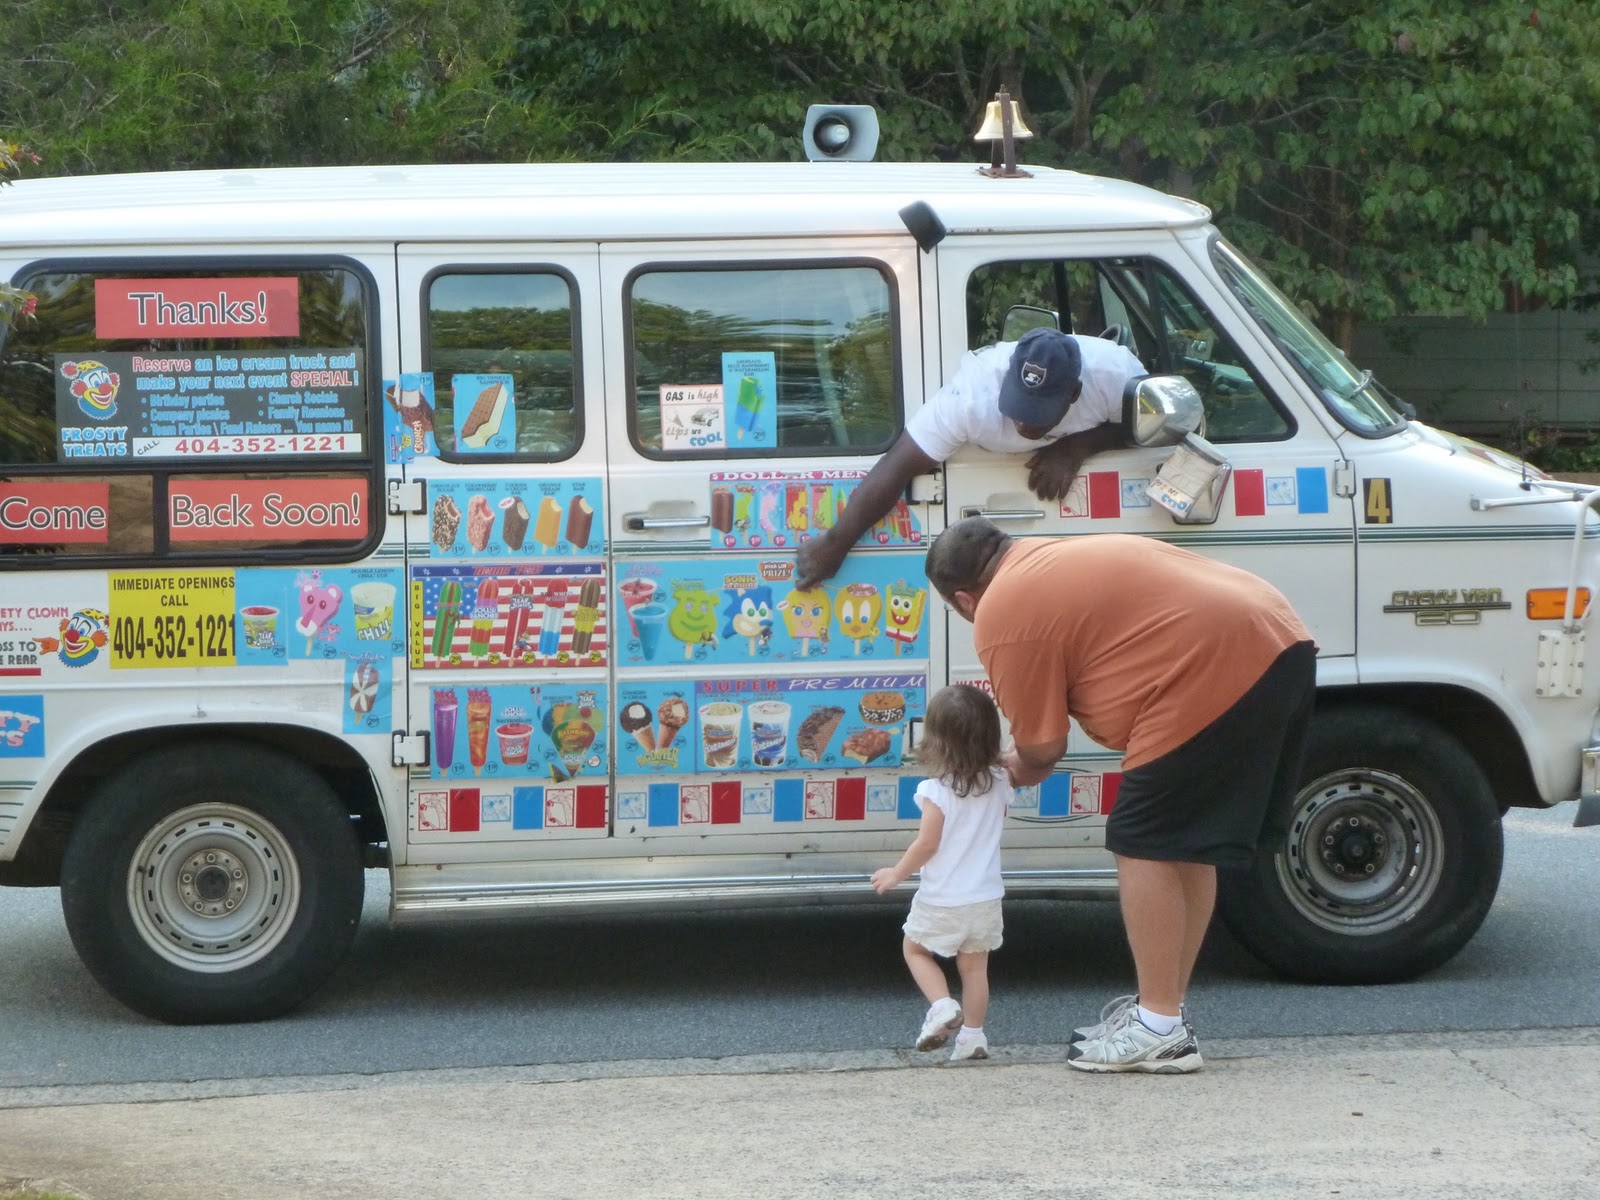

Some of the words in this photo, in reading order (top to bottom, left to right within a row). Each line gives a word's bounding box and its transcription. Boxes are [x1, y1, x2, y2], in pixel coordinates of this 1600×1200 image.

[129, 291, 267, 325] Thanks!
[133, 356, 191, 372] Reserve
[194, 359, 213, 372] an
[216, 355, 238, 371] ice
[241, 357, 287, 370] cream
[289, 354, 326, 369] truck
[329, 352, 356, 368] and
[136, 374, 176, 390] make
[178, 376, 211, 392] your
[214, 373, 245, 389] next
[248, 372, 288, 388] event
[150, 394, 189, 408] Birthday
[192, 394, 225, 407] parties
[268, 392, 302, 404] Church
[304, 391, 339, 404] Socials
[666, 392, 683, 401] GAS
[688, 392, 694, 400] is
[697, 389, 719, 402] high
[150, 409, 194, 423] Company
[196, 408, 230, 421] picnics
[268, 407, 299, 420] Family
[301, 406, 345, 418] Reunions
[61, 426, 128, 441] FROSTY
[151, 424, 176, 436] Team
[179, 423, 212, 435] Parties
[221, 422, 244, 435] Fund
[246, 422, 281, 434] Raisers
[296, 420, 313, 433] You
[315, 422, 342, 432] name
[412, 420, 425, 454] CRUNCH
[690, 432, 723, 446] COOL
[63, 442, 127, 457] TREATS
[137, 440, 160, 455] CALL
[175, 436, 345, 453] 404-352-1221
[1367, 478, 1390, 524] 4
[0, 496, 106, 530] Come
[171, 494, 253, 527] Back
[263, 493, 360, 526] Soon!
[724, 575, 757, 584] SONIC
[763, 568, 791, 577] PRIZE!
[113, 578, 175, 590] IMMEDIATE
[178, 576, 235, 589] OPENINGS
[161, 595, 189, 607] CALL
[1392, 590, 1457, 605] CHEVY
[1461, 588, 1503, 604] VAN
[27, 607, 69, 620] CLOWN
[113, 614, 236, 659] 404-352-1221
[18, 641, 37, 652] TO
[8, 654, 37, 665] REAR
[703, 680, 778, 691] SUPER
[788, 676, 927, 690] PREMIUM
